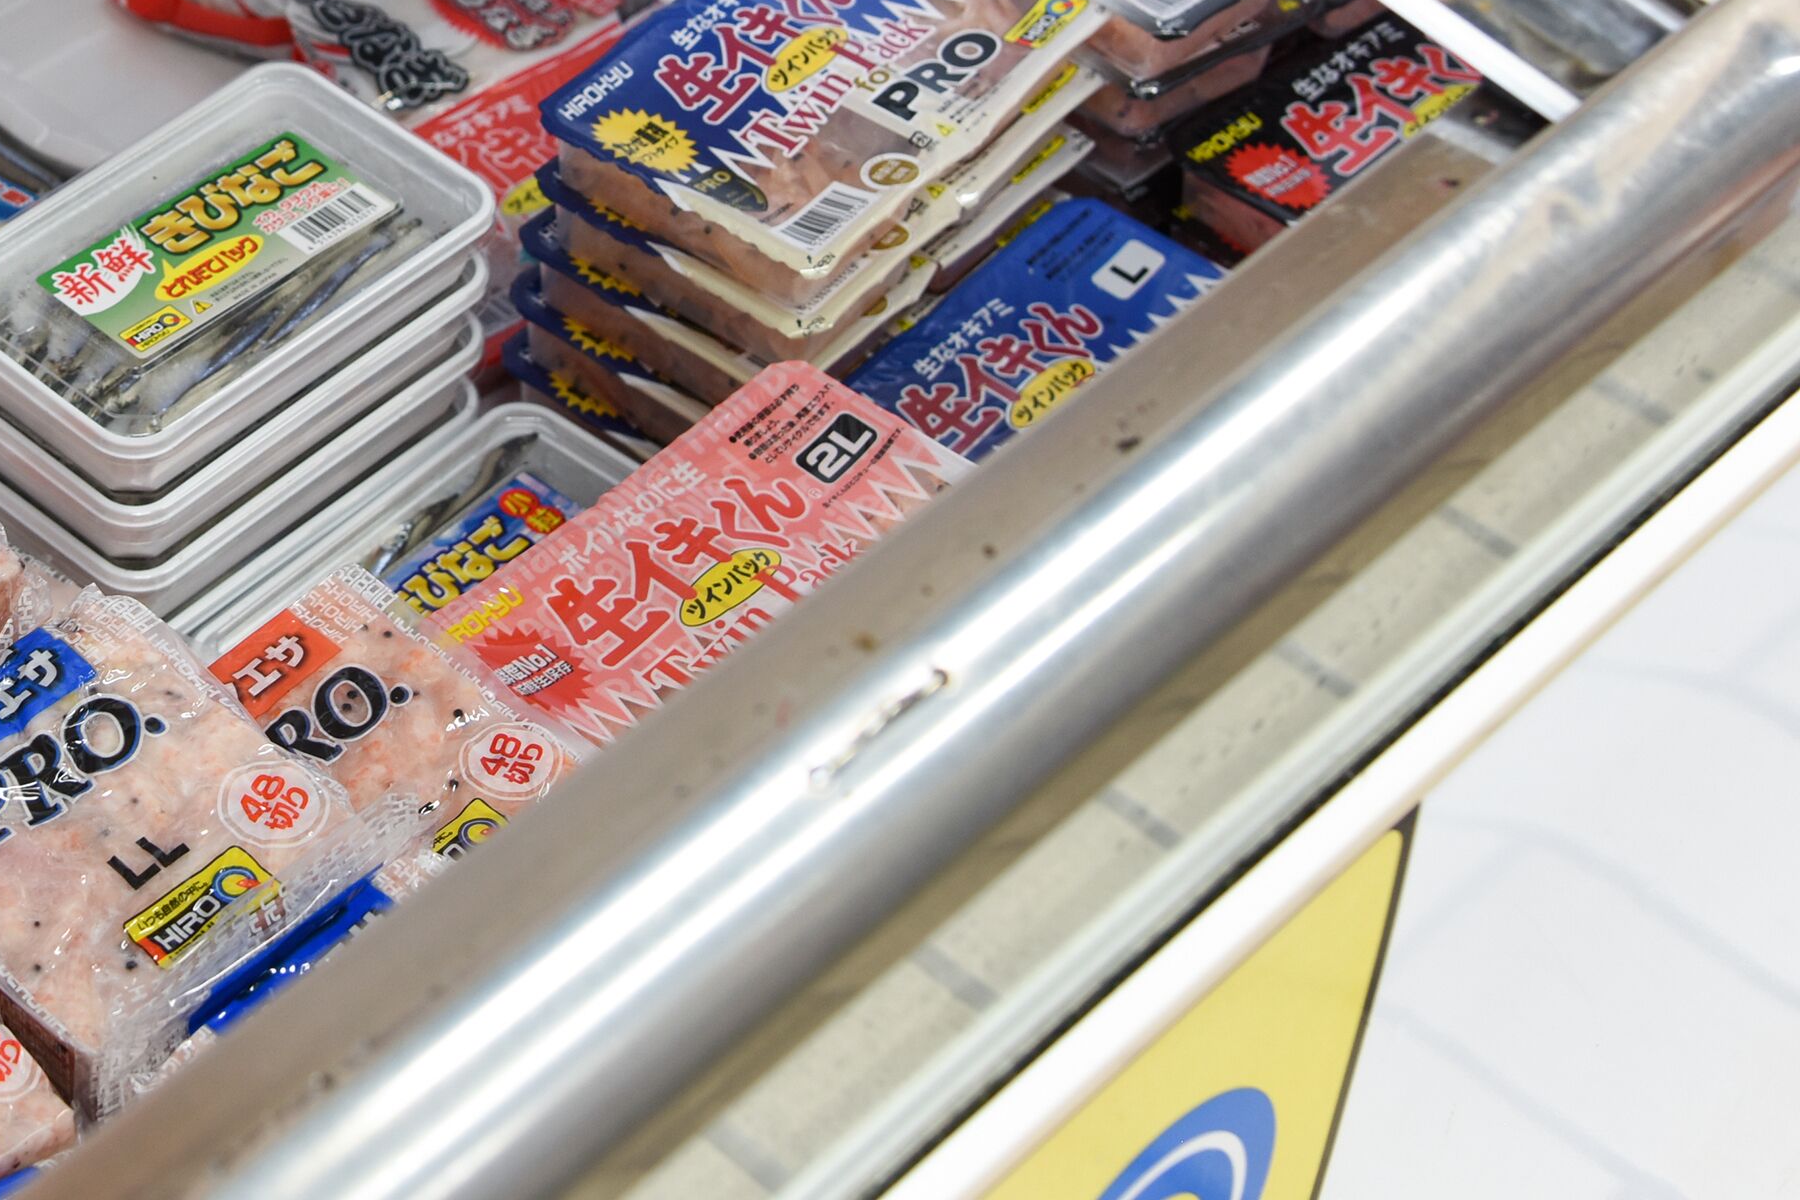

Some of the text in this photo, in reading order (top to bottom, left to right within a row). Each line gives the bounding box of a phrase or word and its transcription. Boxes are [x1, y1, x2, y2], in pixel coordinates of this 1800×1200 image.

[741, 16, 936, 158] Twin Pack
[771, 27, 844, 86] ツインパック
[854, 64, 898, 93] for
[871, 29, 1000, 122] PRO
[1291, 22, 1406, 102] 生なオキアミ
[557, 60, 634, 122] HIROKYU
[140, 138, 328, 254] きびなご
[693, 170, 732, 196] PRO
[59, 240, 155, 306] 新鮮
[161, 235, 259, 298] とれたてパック
[1110, 260, 1150, 285] L
[911, 297, 1017, 382] 生なオキアミ
[896, 301, 1103, 457] 生イキくん
[1015, 360, 1089, 425] ツインパック
[806, 430, 873, 478] 2L
[559, 460, 707, 575] ボイルなのに生
[542, 474, 809, 672] 生イキくん
[681, 550, 777, 623] ツインパック
[479, 732, 520, 777] 48
[240, 774, 286, 823] 48
[264, 786, 309, 831] 切り
[107, 836, 191, 891] LL
